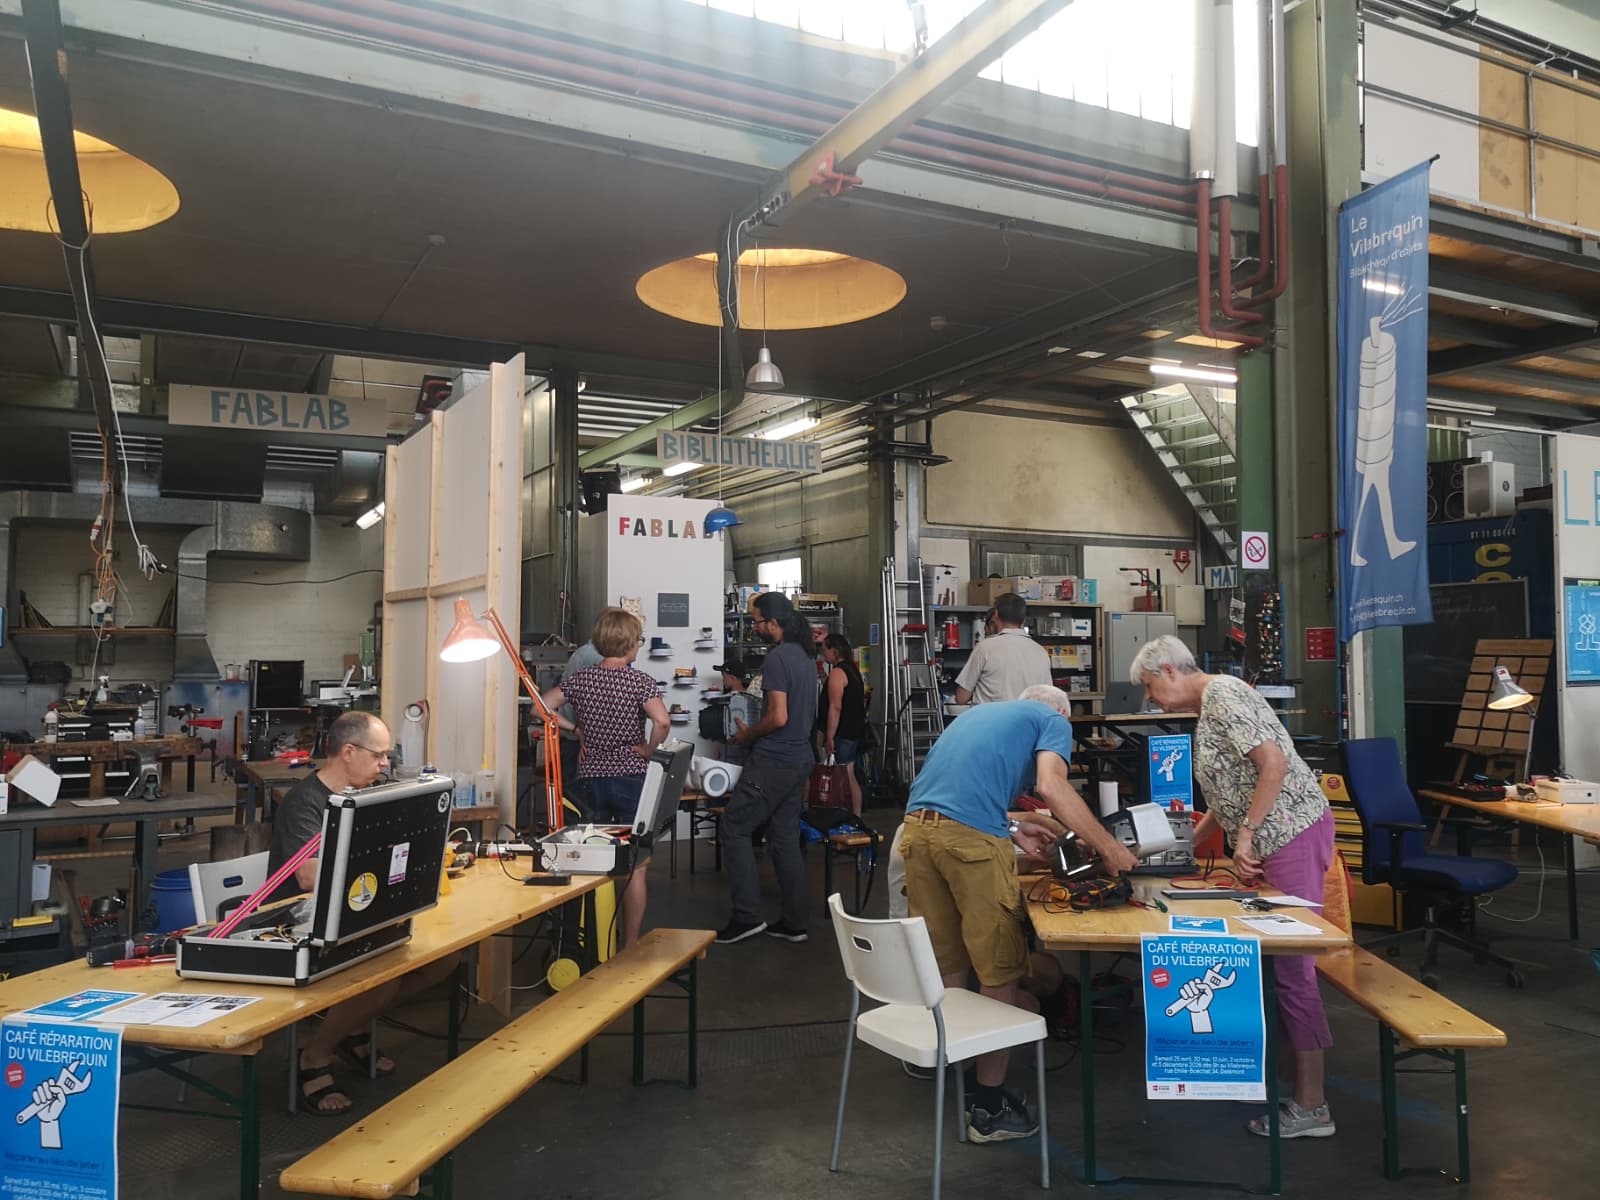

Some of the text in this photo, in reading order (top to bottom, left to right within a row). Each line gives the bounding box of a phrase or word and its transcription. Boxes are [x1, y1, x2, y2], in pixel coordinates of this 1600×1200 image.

[1351, 217, 1368, 234] Le
[211, 390, 350, 431] FABLAB
[663, 432, 817, 470] BIBLIOTHEQUE
[1147, 940, 1254, 955] CAFÉ RÉPARATION
[1152, 955, 1251, 968] DU VILEBREQUIN
[5, 1028, 113, 1051] CAFÉ RÉPARATION
[8, 1046, 108, 1067] DU VILEBREQUIN
